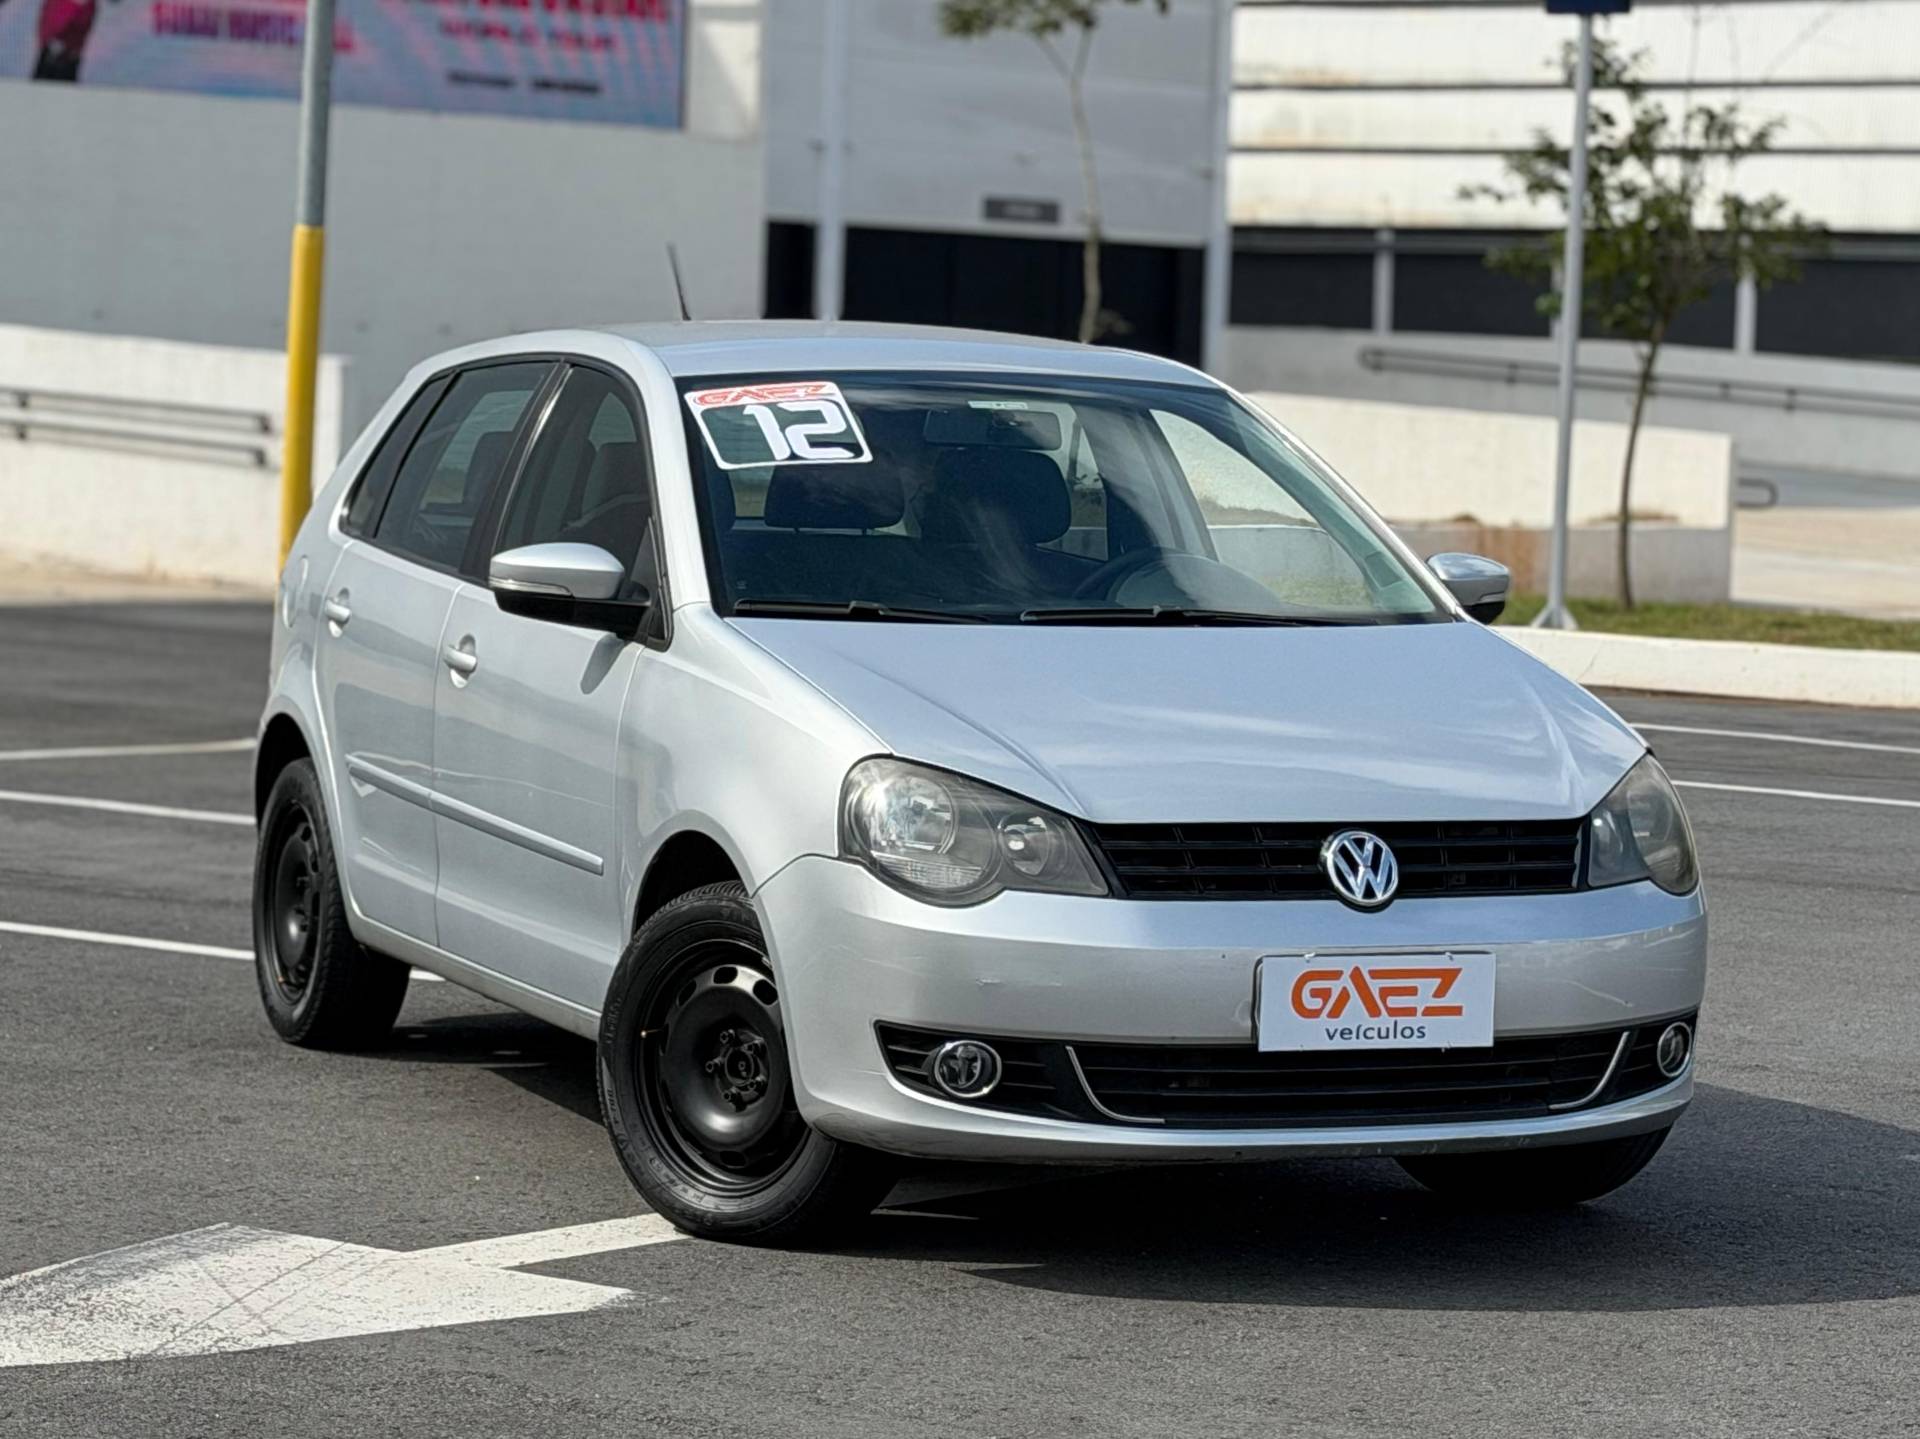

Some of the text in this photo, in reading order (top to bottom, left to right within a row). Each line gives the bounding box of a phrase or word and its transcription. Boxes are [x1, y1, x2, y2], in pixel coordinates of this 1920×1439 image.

[743, 399, 855, 461] 12
[1291, 965, 1464, 1019] GAEZ
[1325, 1020, 1426, 1041] veículos
